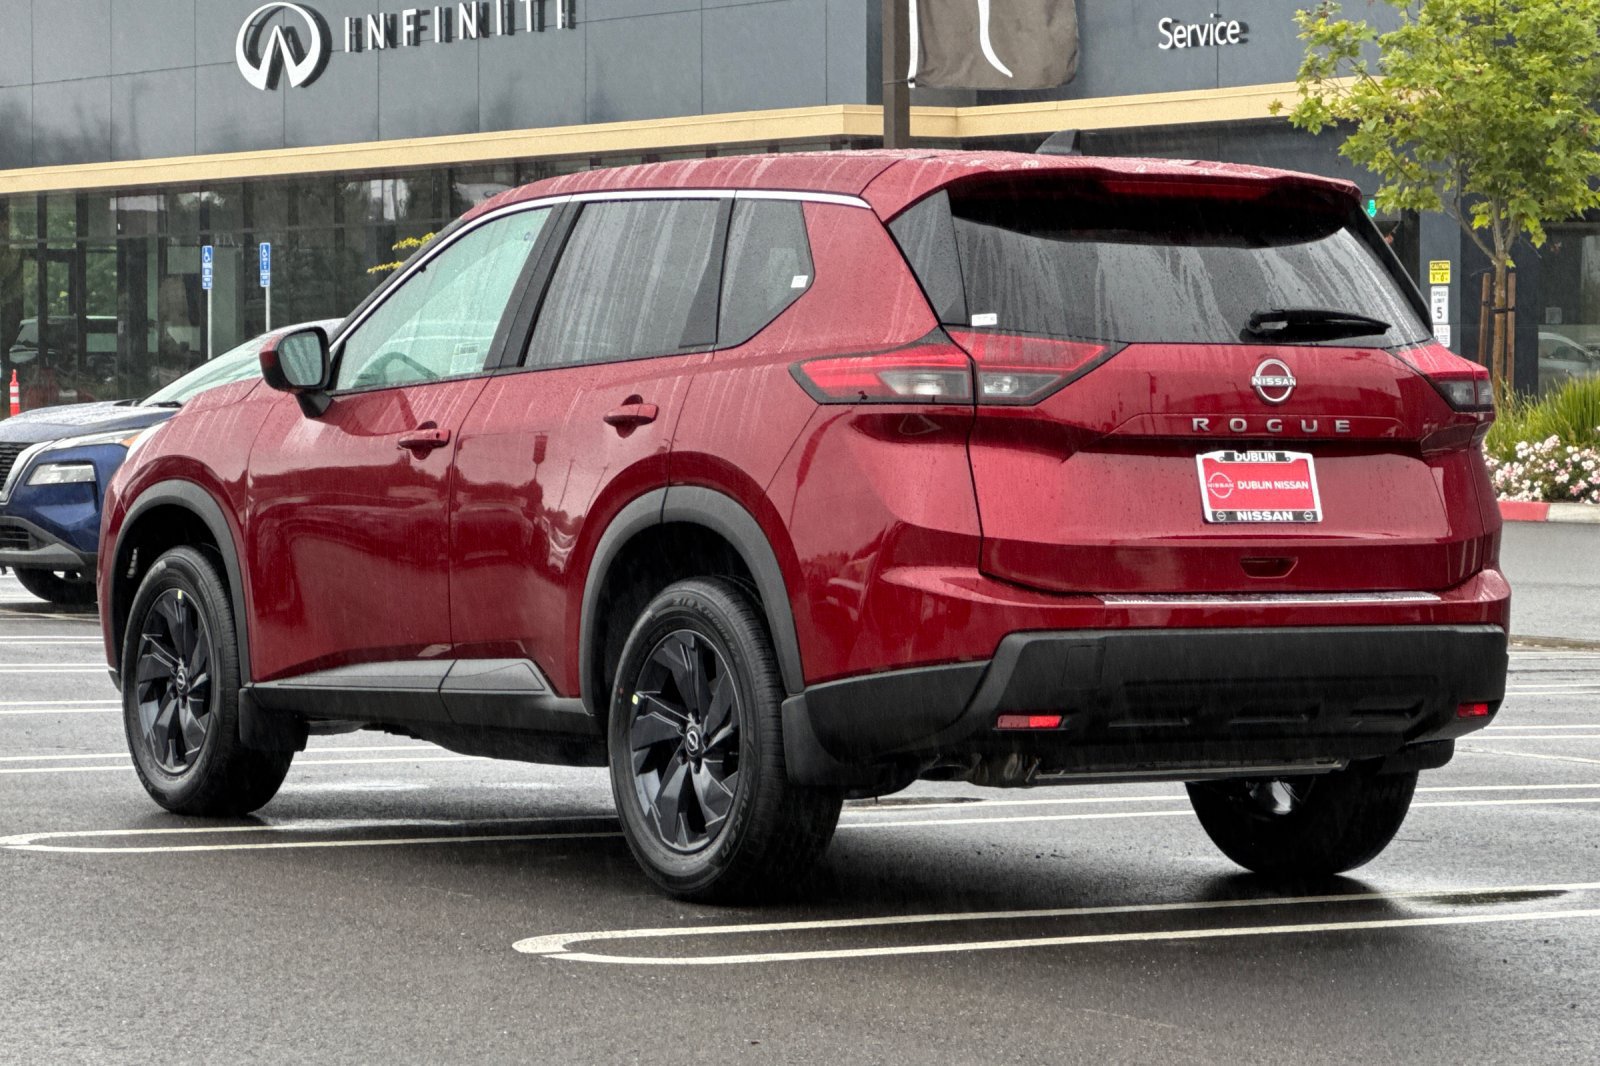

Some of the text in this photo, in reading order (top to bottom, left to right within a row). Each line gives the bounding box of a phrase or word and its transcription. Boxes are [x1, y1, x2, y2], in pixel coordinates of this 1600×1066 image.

[344, 0, 563, 53] INFINITI
[1158, 13, 1240, 49] Service
[1436, 307, 1443, 319] 5
[1251, 375, 1296, 387] NISSAN
[1191, 418, 1351, 433] ROGUE
[1234, 452, 1277, 462] DUBLIN
[1237, 481, 1309, 490] DUBLIN NISSAN
[1236, 511, 1294, 521] NISSAN
